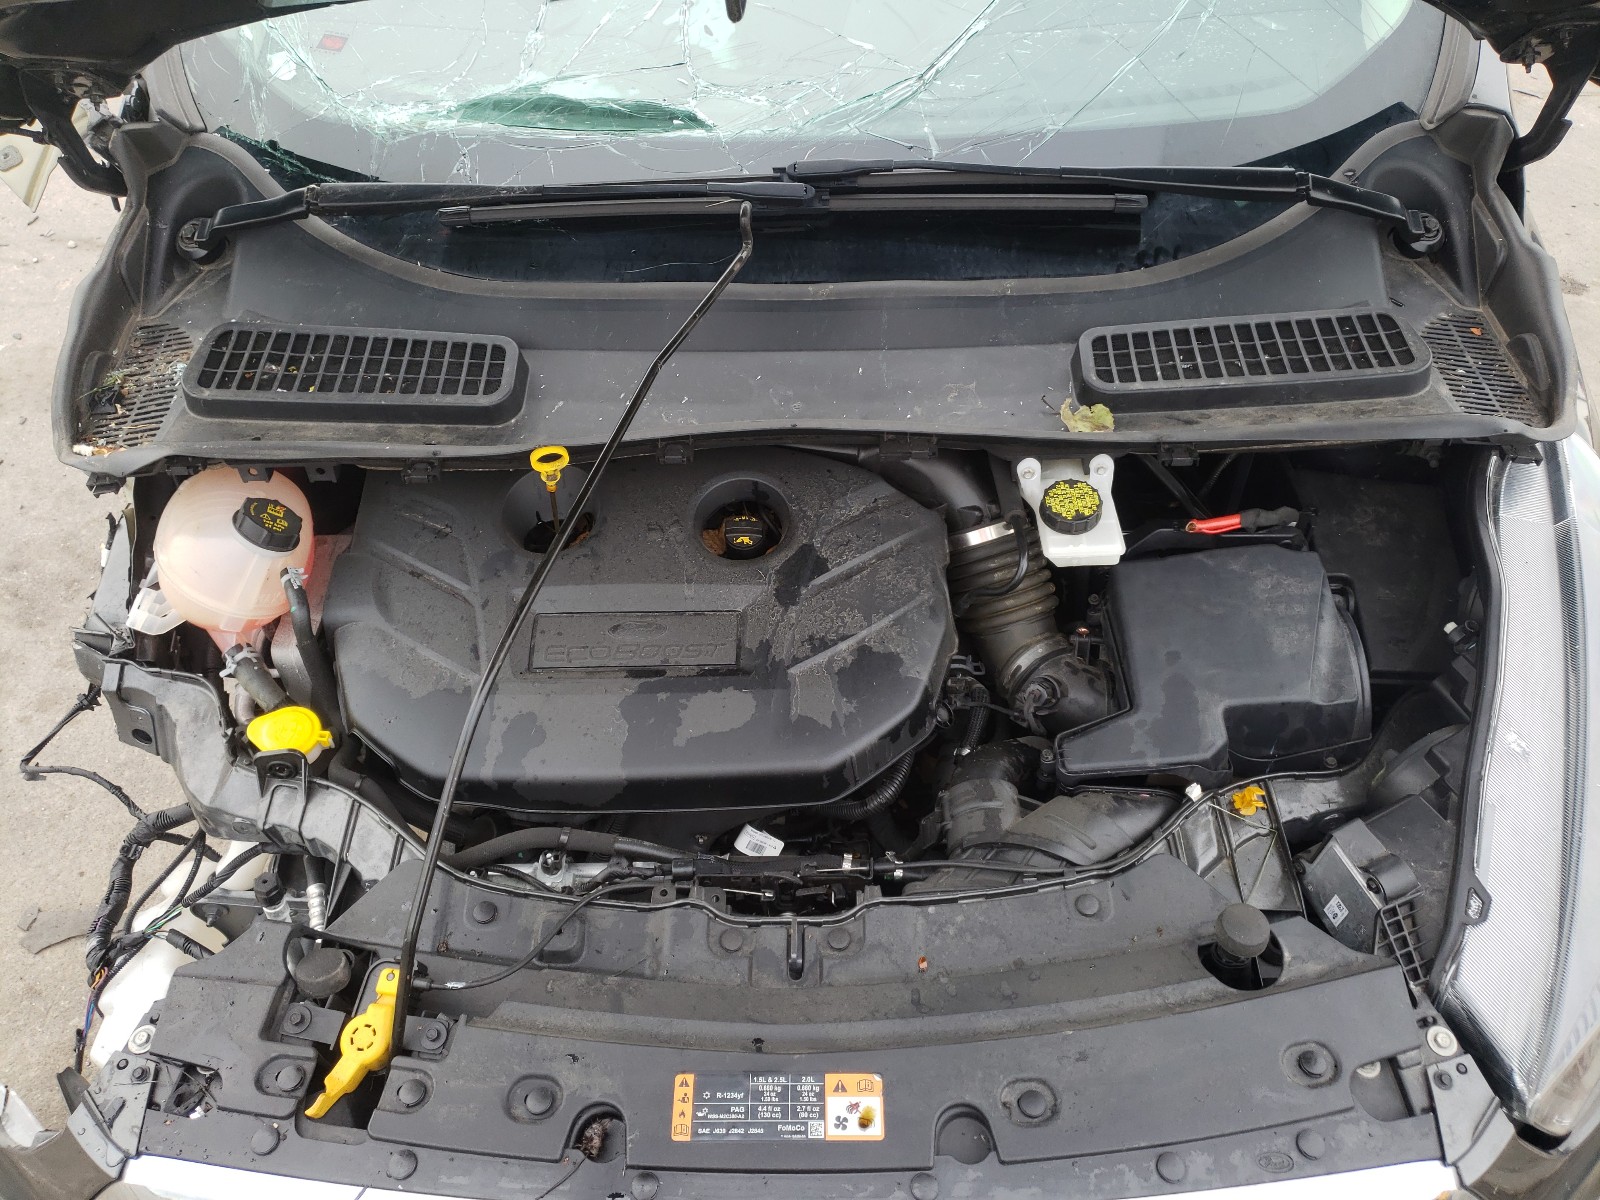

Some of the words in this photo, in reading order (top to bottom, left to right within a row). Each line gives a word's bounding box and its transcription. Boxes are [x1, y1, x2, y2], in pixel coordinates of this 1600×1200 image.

[812, 1084, 820, 1093] kg
[716, 1092, 744, 1100] R-1234yf
[771, 1111, 782, 1119] cc)
[808, 1111, 819, 1119] cc)
[777, 1124, 805, 1132] FoMoCo
